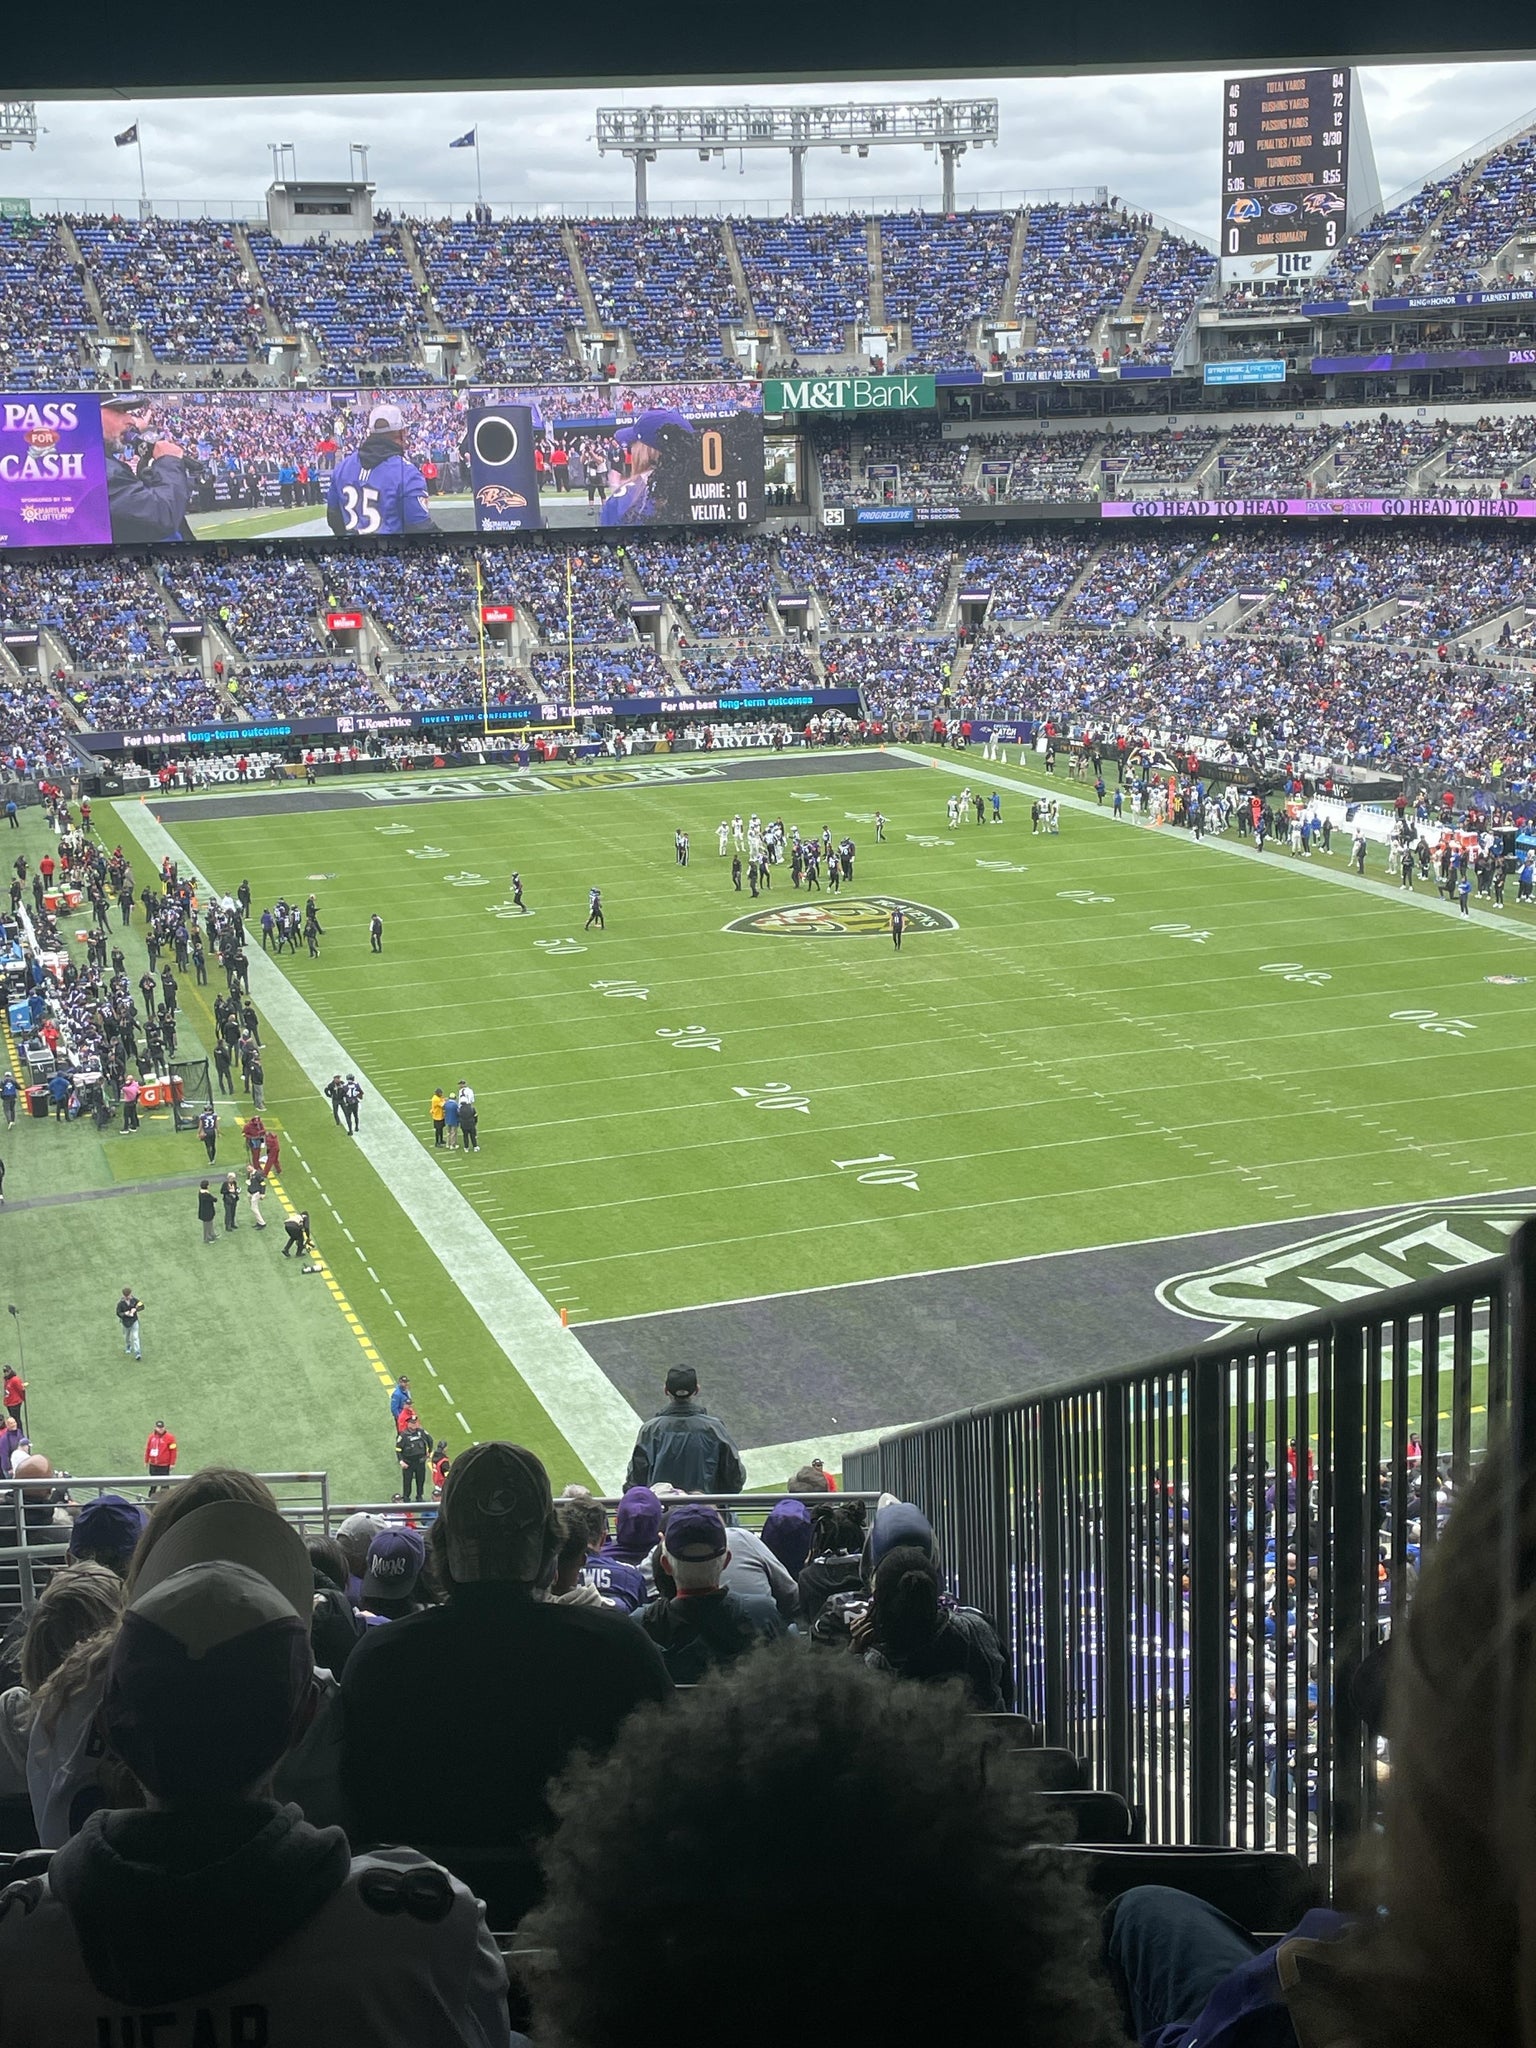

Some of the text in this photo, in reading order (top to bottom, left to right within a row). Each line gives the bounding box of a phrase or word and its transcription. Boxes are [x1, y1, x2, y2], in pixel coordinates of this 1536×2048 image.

[1267, 79, 1306, 93] TOTAL YARDS
[1332, 73, 1344, 88] 84
[1229, 85, 1240, 98] 46
[1262, 98, 1309, 112] RUSHING YARDS
[1333, 92, 1344, 107] 72
[1229, 104, 1238, 117] 15
[1262, 116, 1308, 132] PASSING YARDS
[1334, 112, 1342, 126] 12
[1228, 122, 1237, 136] 31
[1257, 138, 1288, 151] PENALTIES
[1292, 135, 1312, 147] YARDS
[1322, 131, 1342, 146] 3/30
[1228, 140, 1244, 155] 2/10
[1266, 155, 1302, 168] TURNOVERS
[1338, 150, 1342, 164] 1
[1254, 172, 1314, 188] TIME OF POSSESSION
[1322, 169, 1340, 184] 9:55
[1228, 177, 1245, 192] 5:05
[1257, 230, 1308, 246] GAME SUMMARY
[1326, 220, 1336, 246] 3
[1229, 228, 1239, 254] 0
[1276, 254, 1312, 276] Lite
[1409, 298, 1426, 307] RING
[1430, 297, 1456, 306] HONOR
[1482, 294, 1510, 302] EARNEST
[1512, 292, 1534, 300] BYNER
[1508, 350, 1536, 364] PASS
[1026, 371, 1037, 380] FOR
[1038, 370, 1052, 380] HELP
[780, 378, 920, 410] M&T Bank
[2, 403, 78, 432] PASS
[616, 417, 633, 425] BUD
[682, 411, 718, 420] HDOWN
[32, 434, 54, 443] FOR
[702, 431, 722, 477] 0
[0, 453, 86, 482] CASH
[736, 480, 747, 499] 11
[342, 486, 382, 535] 35
[738, 502, 747, 520] 0
[858, 510, 912, 520] PROGRESSIVE
[1132, 500, 1519, 516] GO HEAD TO HEAD PASS CASH GO HEAD TO HEAD
[661, 696, 813, 712] For the best long-term outcomes
[421, 716, 450, 724] INVEST
[454, 714, 474, 722] WITH
[478, 710, 529, 720] CONFIDENCE
[124, 726, 292, 746] For the best long-term outcomes
[367, 766, 714, 800] BALTIMORE
[655, 1024, 722, 1048] 30
[144, 1090, 156, 1101] G
[731, 1082, 811, 1110] 20
[204, 1119, 214, 1128] 33
[830, 1153, 919, 1185] 10
